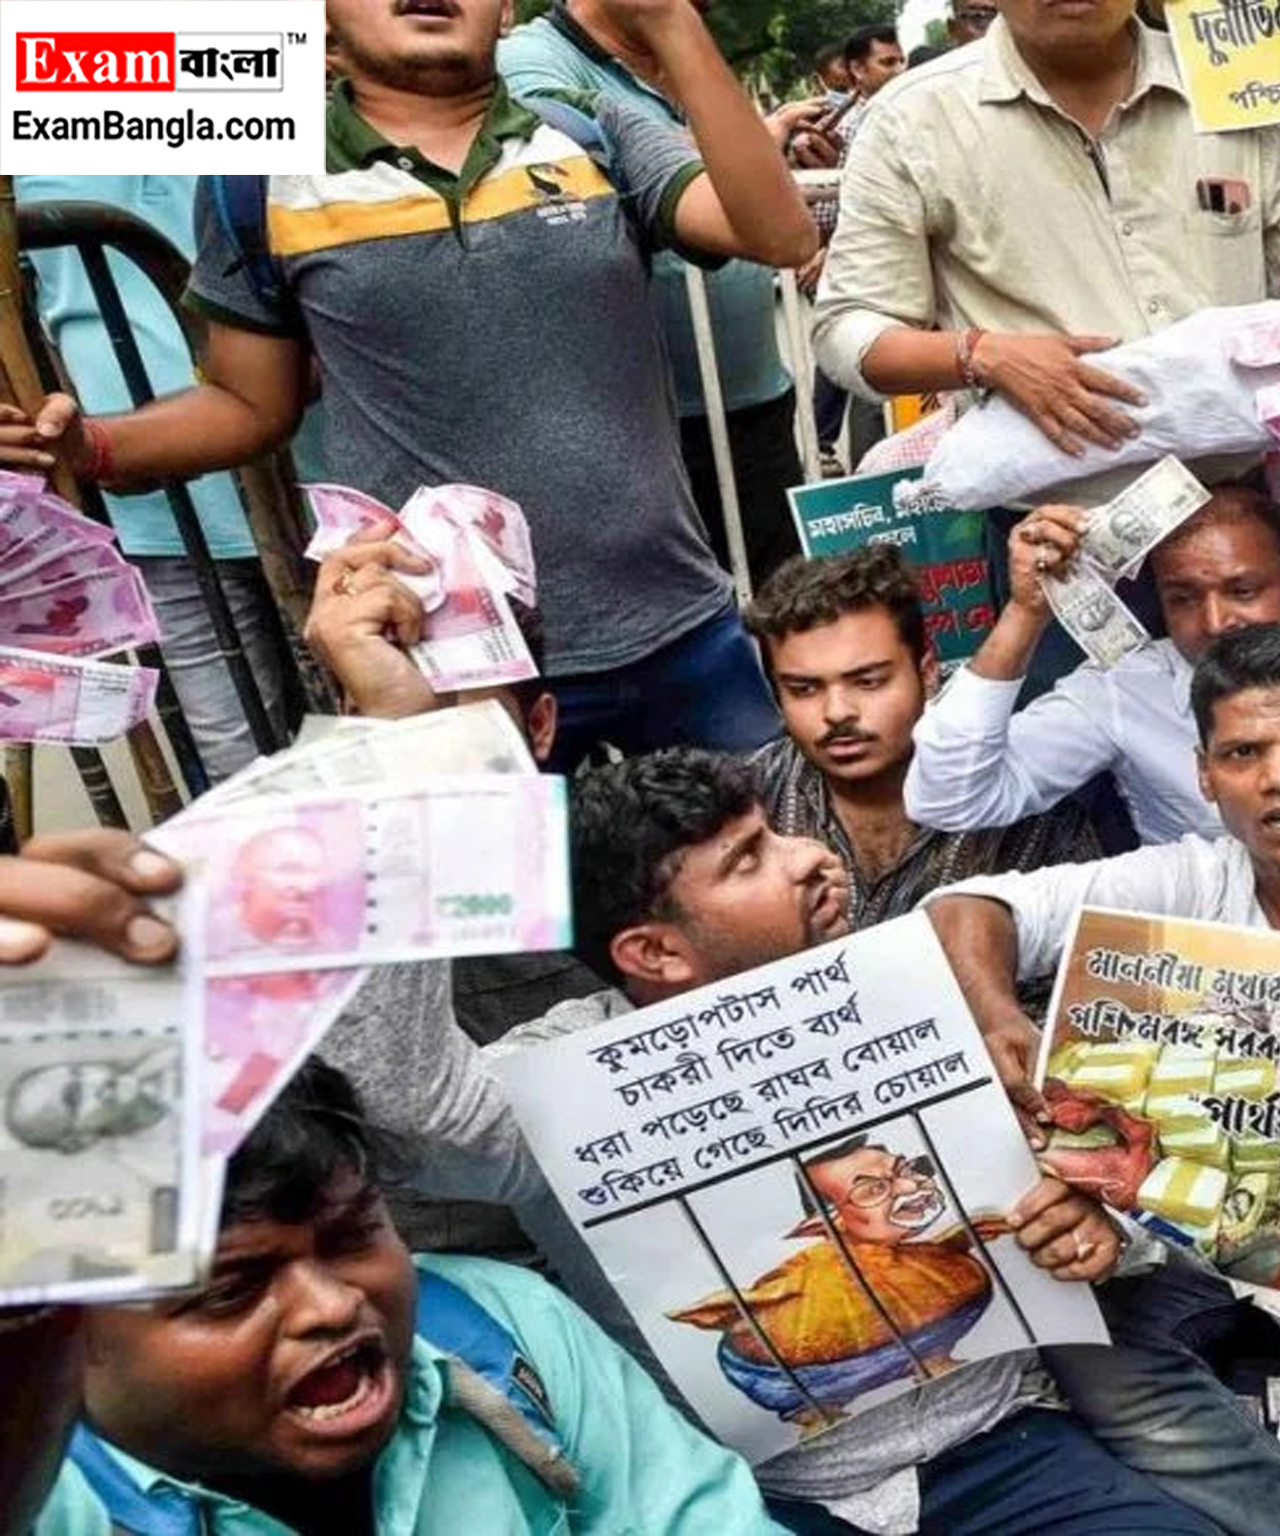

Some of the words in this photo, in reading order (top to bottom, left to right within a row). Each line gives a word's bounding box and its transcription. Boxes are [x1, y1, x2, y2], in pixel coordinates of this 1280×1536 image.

[587, 985, 781, 1073] কুমড়োপটাস
[790, 950, 851, 996] পার্থ
[614, 1052, 713, 1106] চাকরী
[716, 1026, 796, 1072] দিতে
[801, 992, 862, 1036] ব্যর্থ
[575, 1131, 633, 1165] ধরা
[641, 1090, 753, 1139] পড়েছে
[750, 1058, 832, 1103] রাঘব
[842, 1017, 941, 1072] বোয়াল
[578, 1157, 684, 1205] শুকিয়ে
[694, 1126, 775, 1169] গেছে
[773, 1091, 863, 1139] দিদির
[874, 1051, 970, 1105] চোয়াল
